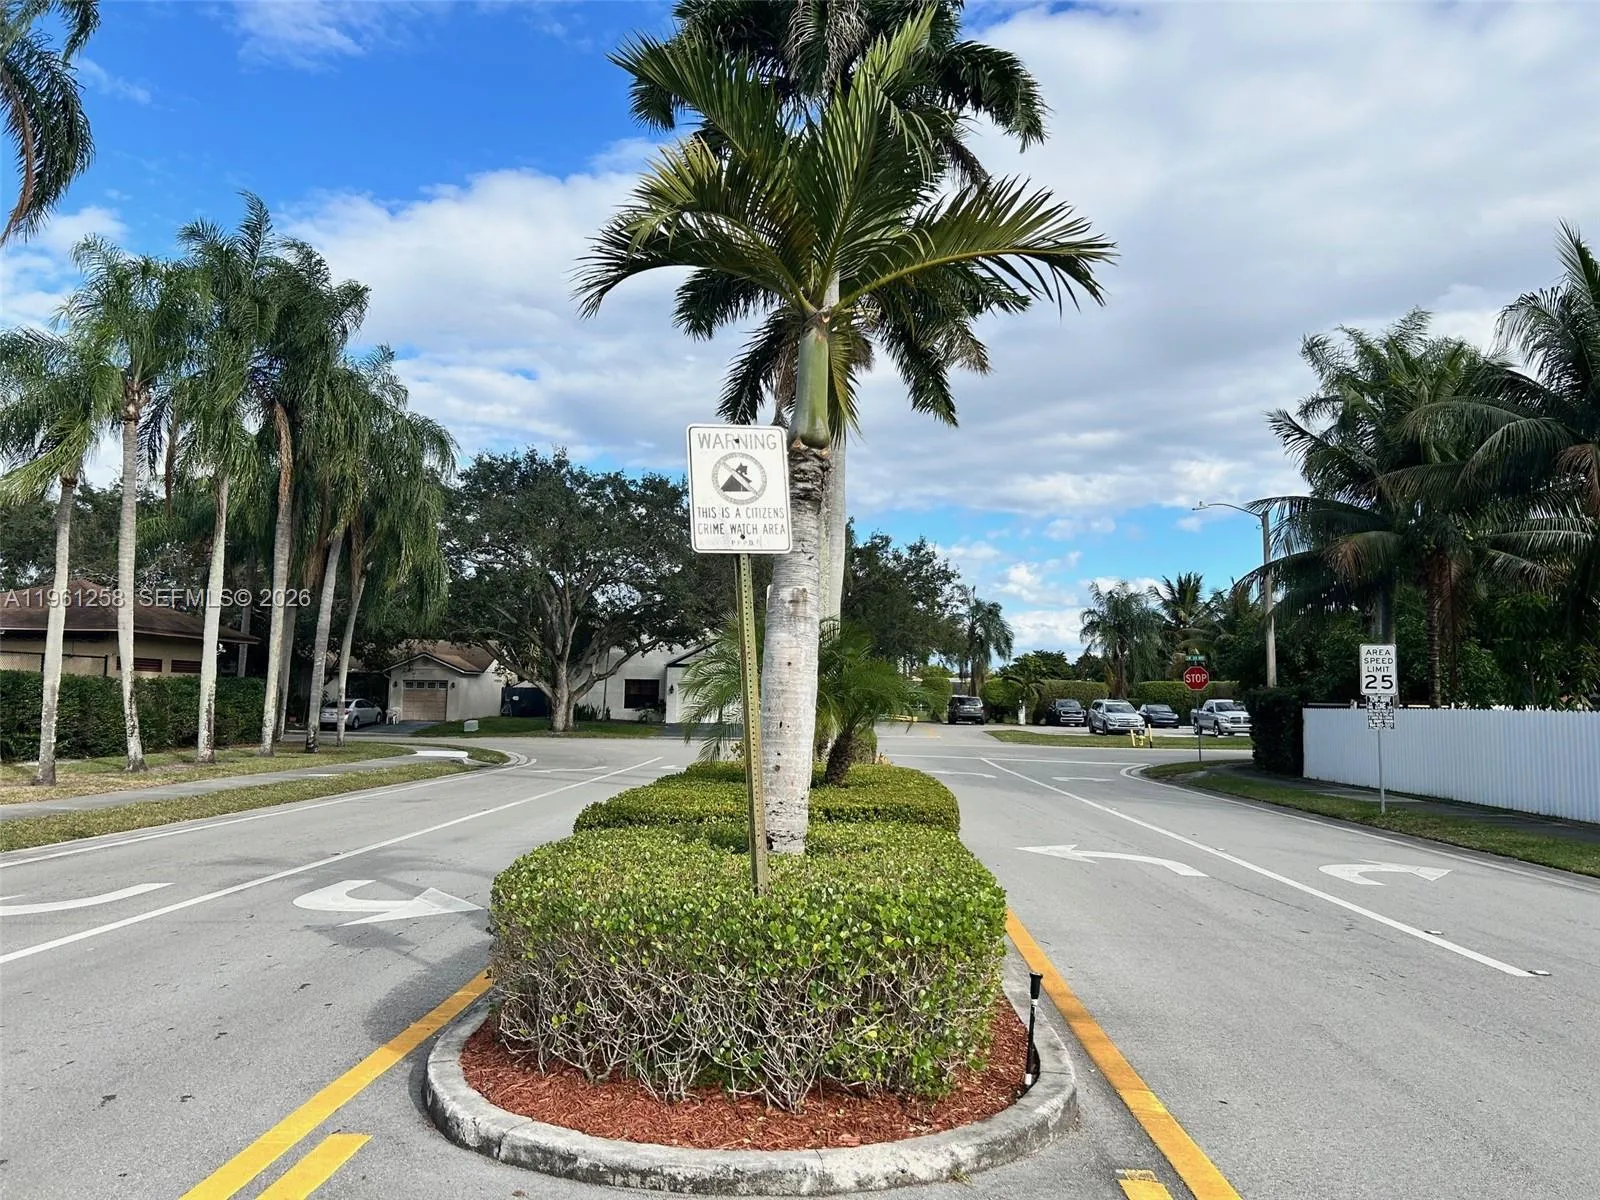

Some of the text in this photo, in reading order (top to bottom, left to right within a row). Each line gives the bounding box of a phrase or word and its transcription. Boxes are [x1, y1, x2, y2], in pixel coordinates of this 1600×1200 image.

[698, 433, 777, 450] WARNING
[698, 507, 785, 519] THIS IS A CITIZENS
[698, 523, 786, 535] CRIME WATCH AREA
[1185, 673, 1207, 683] STOP
[1365, 675, 1393, 689] 25
